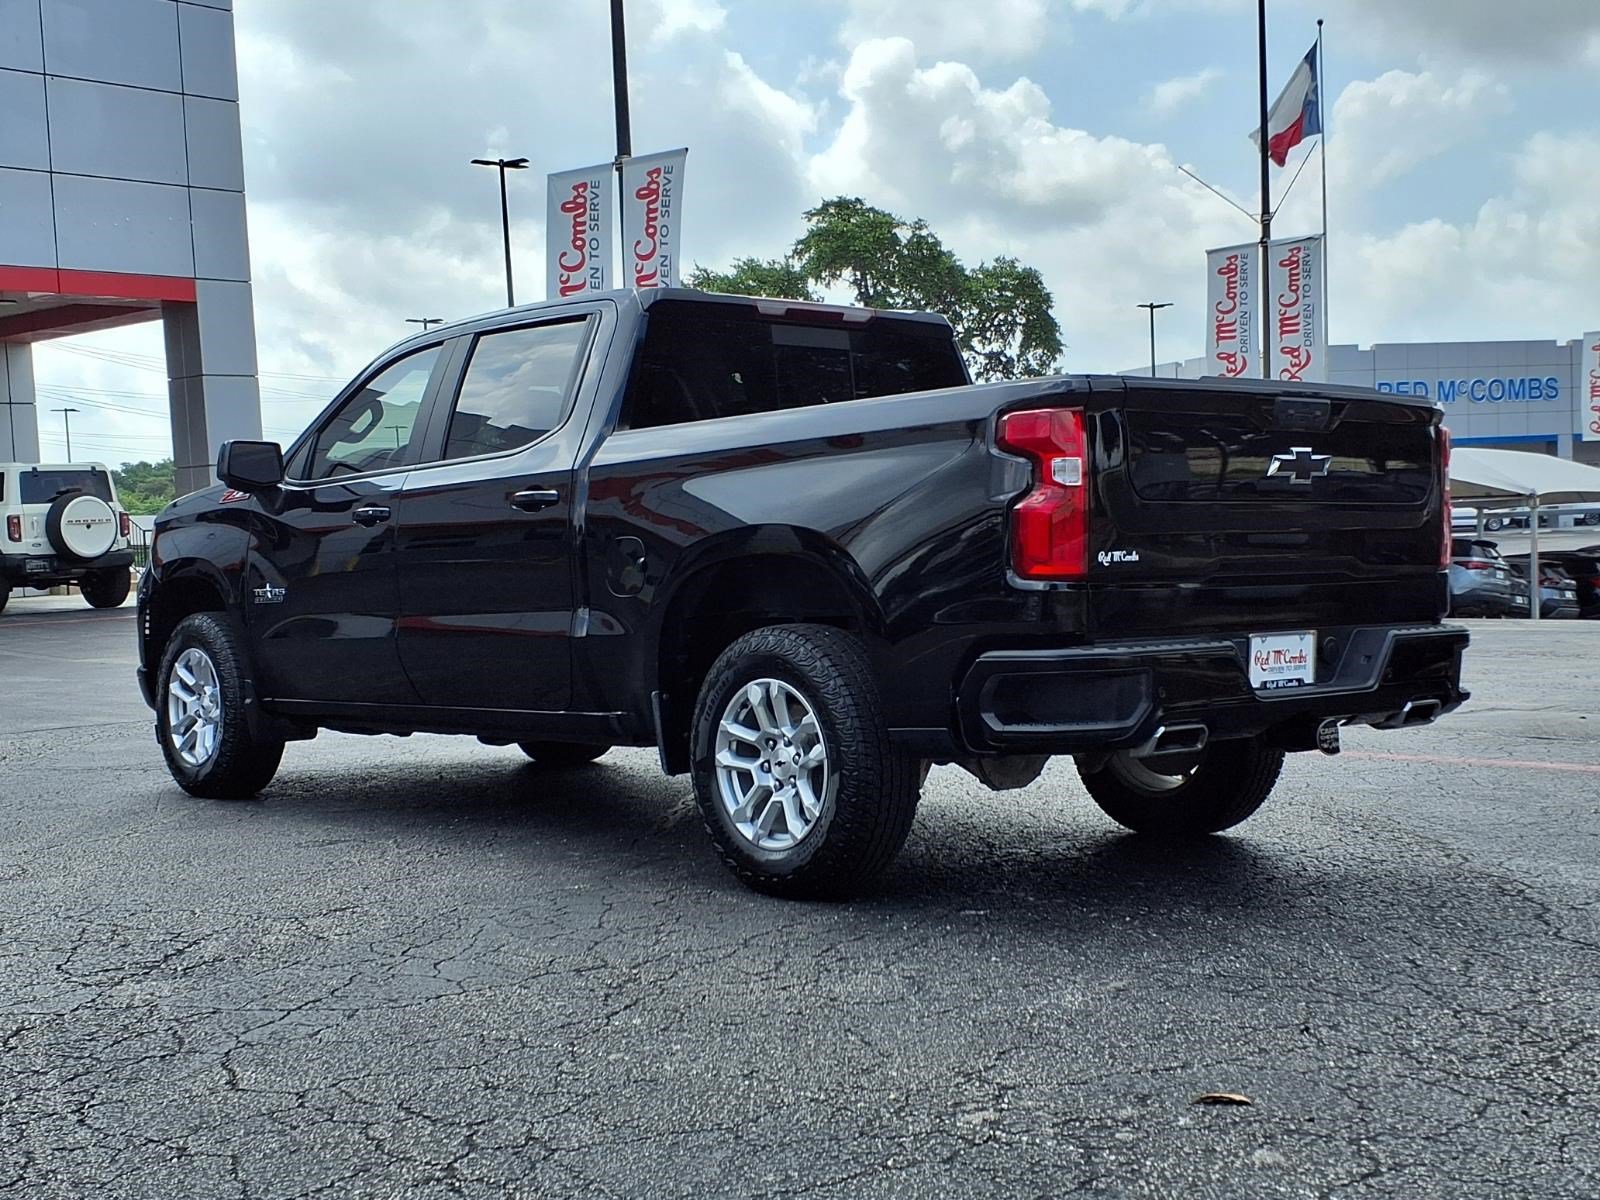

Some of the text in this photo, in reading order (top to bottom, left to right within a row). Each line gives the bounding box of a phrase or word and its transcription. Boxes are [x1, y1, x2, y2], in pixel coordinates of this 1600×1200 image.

[589, 180, 600, 231] SERVE
[661, 164, 674, 218] SERVE
[589, 239, 600, 261] TO
[659, 225, 670, 248] TO
[1239, 253, 1249, 353] DRIVEN TO SERVE
[1302, 284, 1311, 300] TO
[1215, 254, 1247, 378] ed McCombs
[1278, 246, 1312, 381] Red McCombs
[1303, 304, 1312, 347] DRIVEN
[1437, 376, 1560, 403] McCOMBS
[1097, 551, 1111, 566] Red
[1254, 648, 1308, 672] Red McCombs
